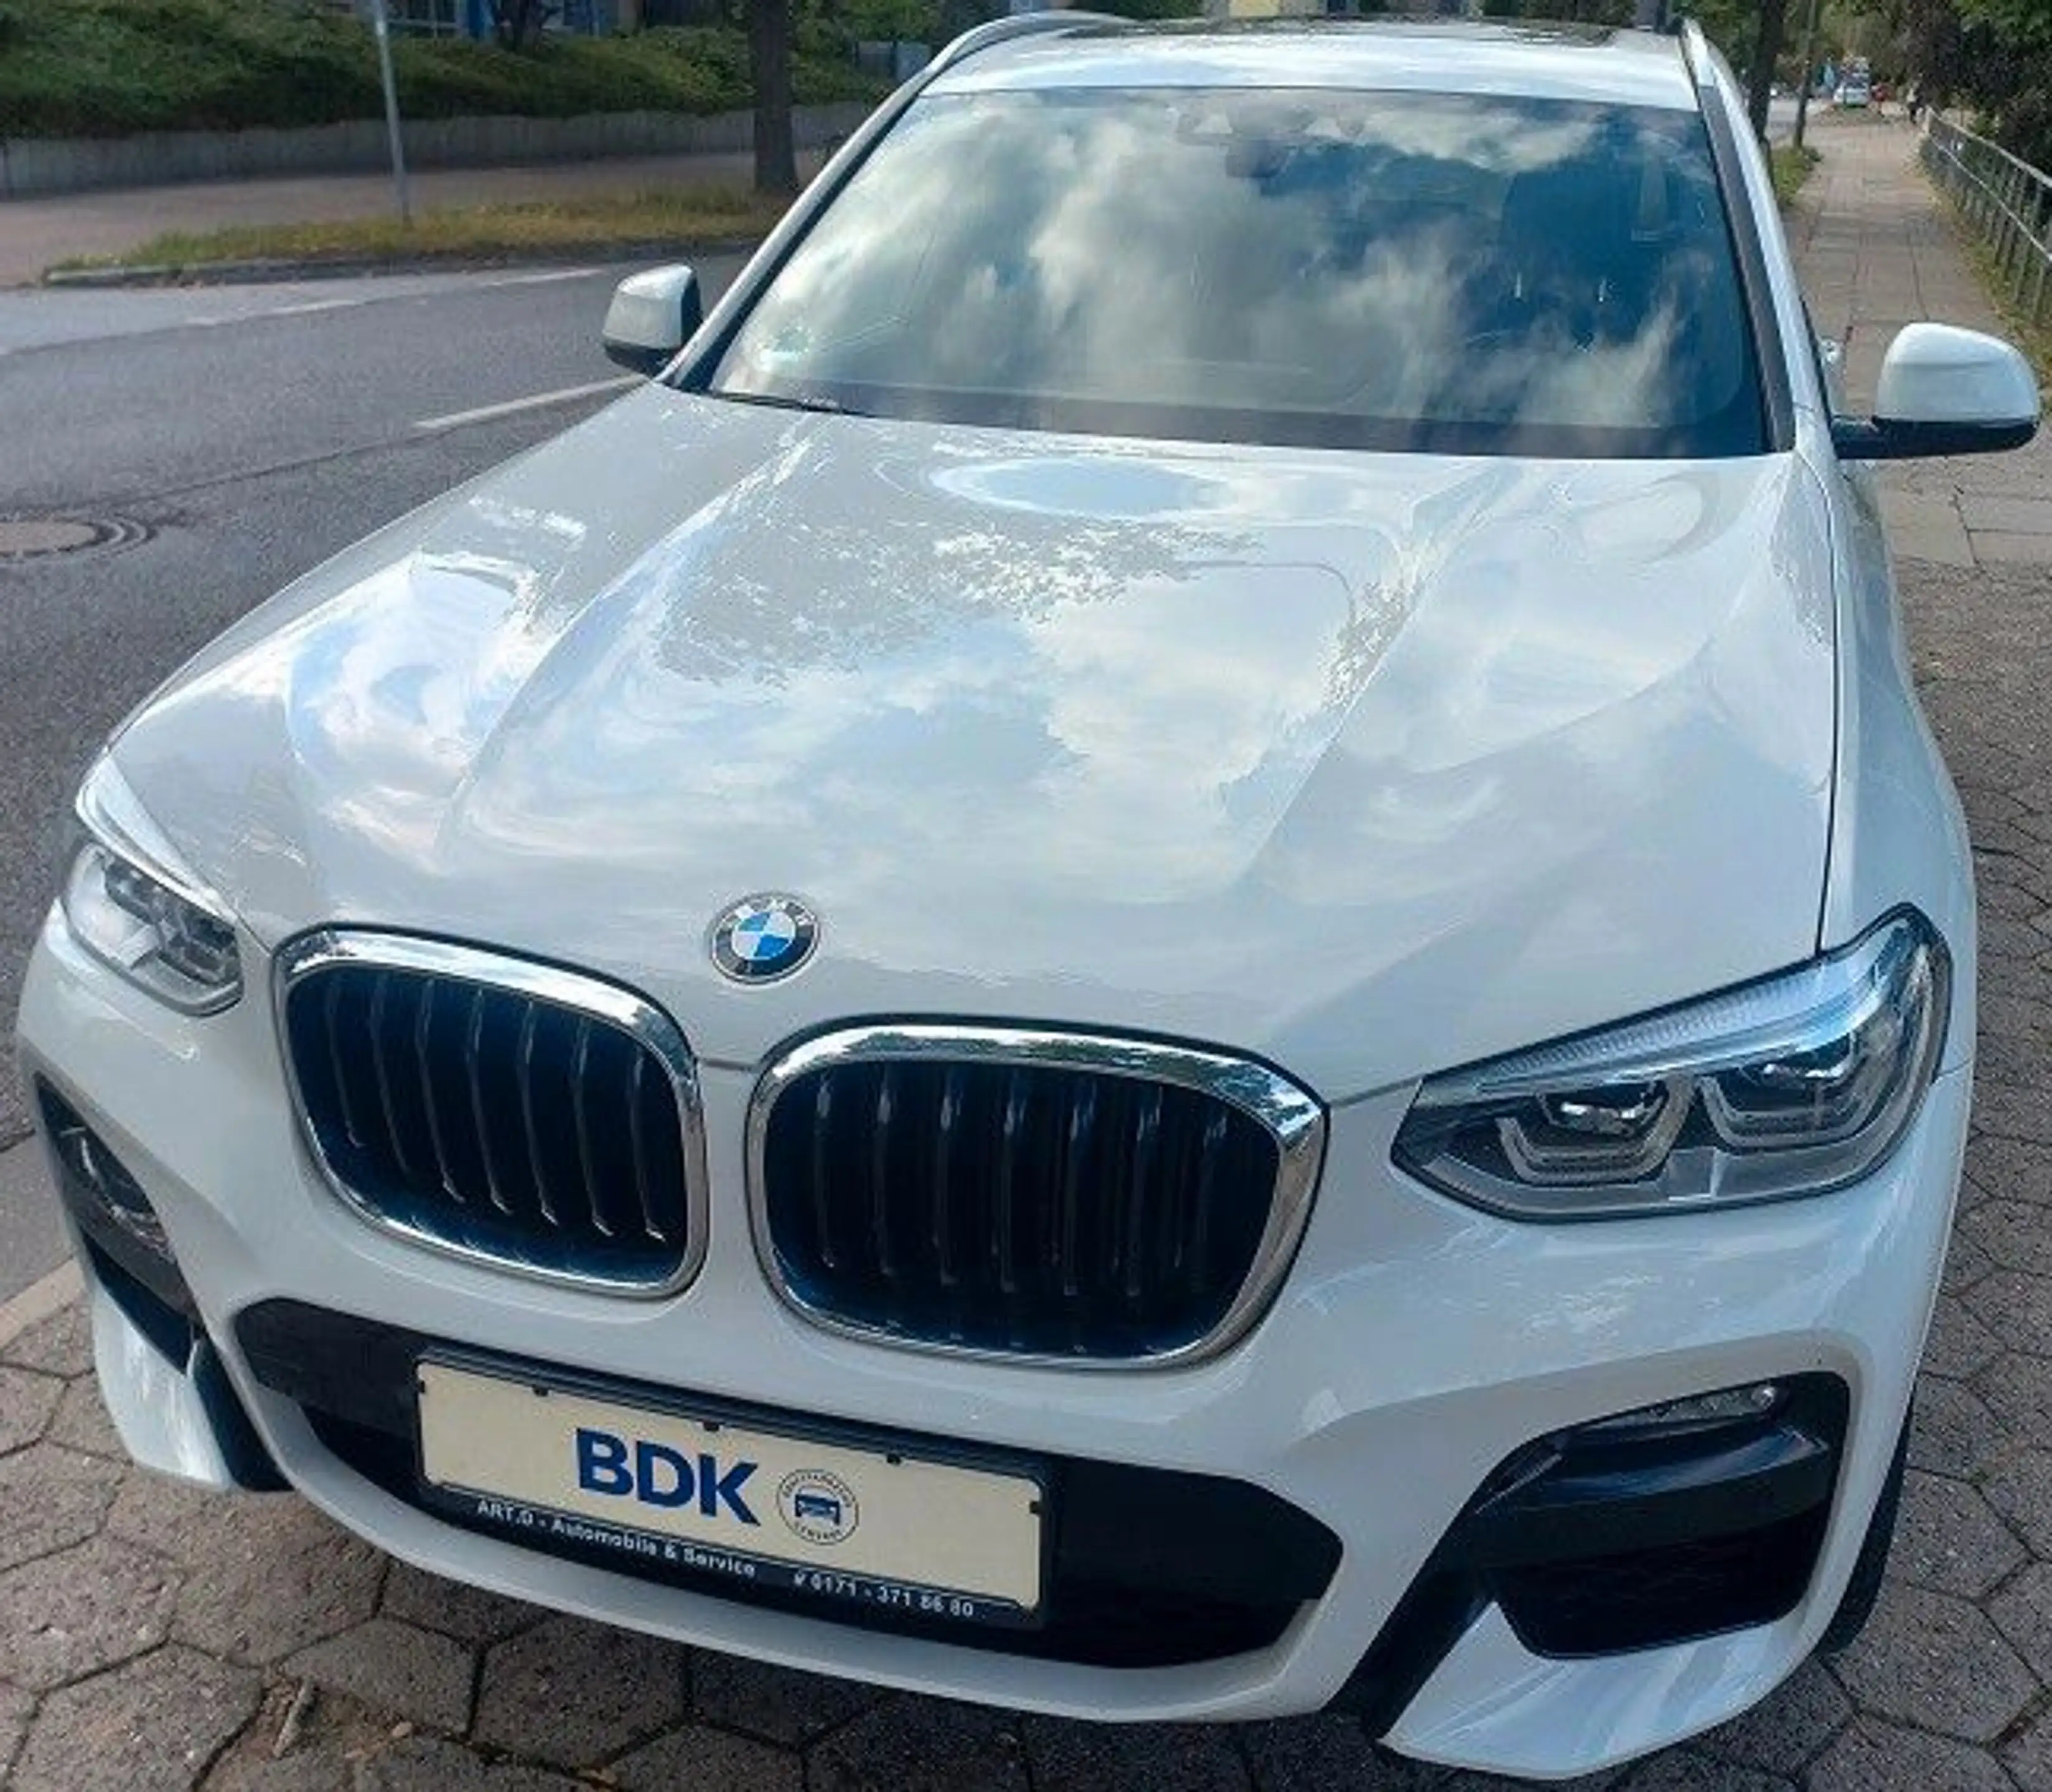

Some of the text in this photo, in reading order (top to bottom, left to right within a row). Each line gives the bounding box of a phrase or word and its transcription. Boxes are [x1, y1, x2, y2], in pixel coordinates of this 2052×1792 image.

[576, 1427, 762, 1526] BDK
[664, 1539, 677, 1560] &
[683, 1546, 756, 1578] Service
